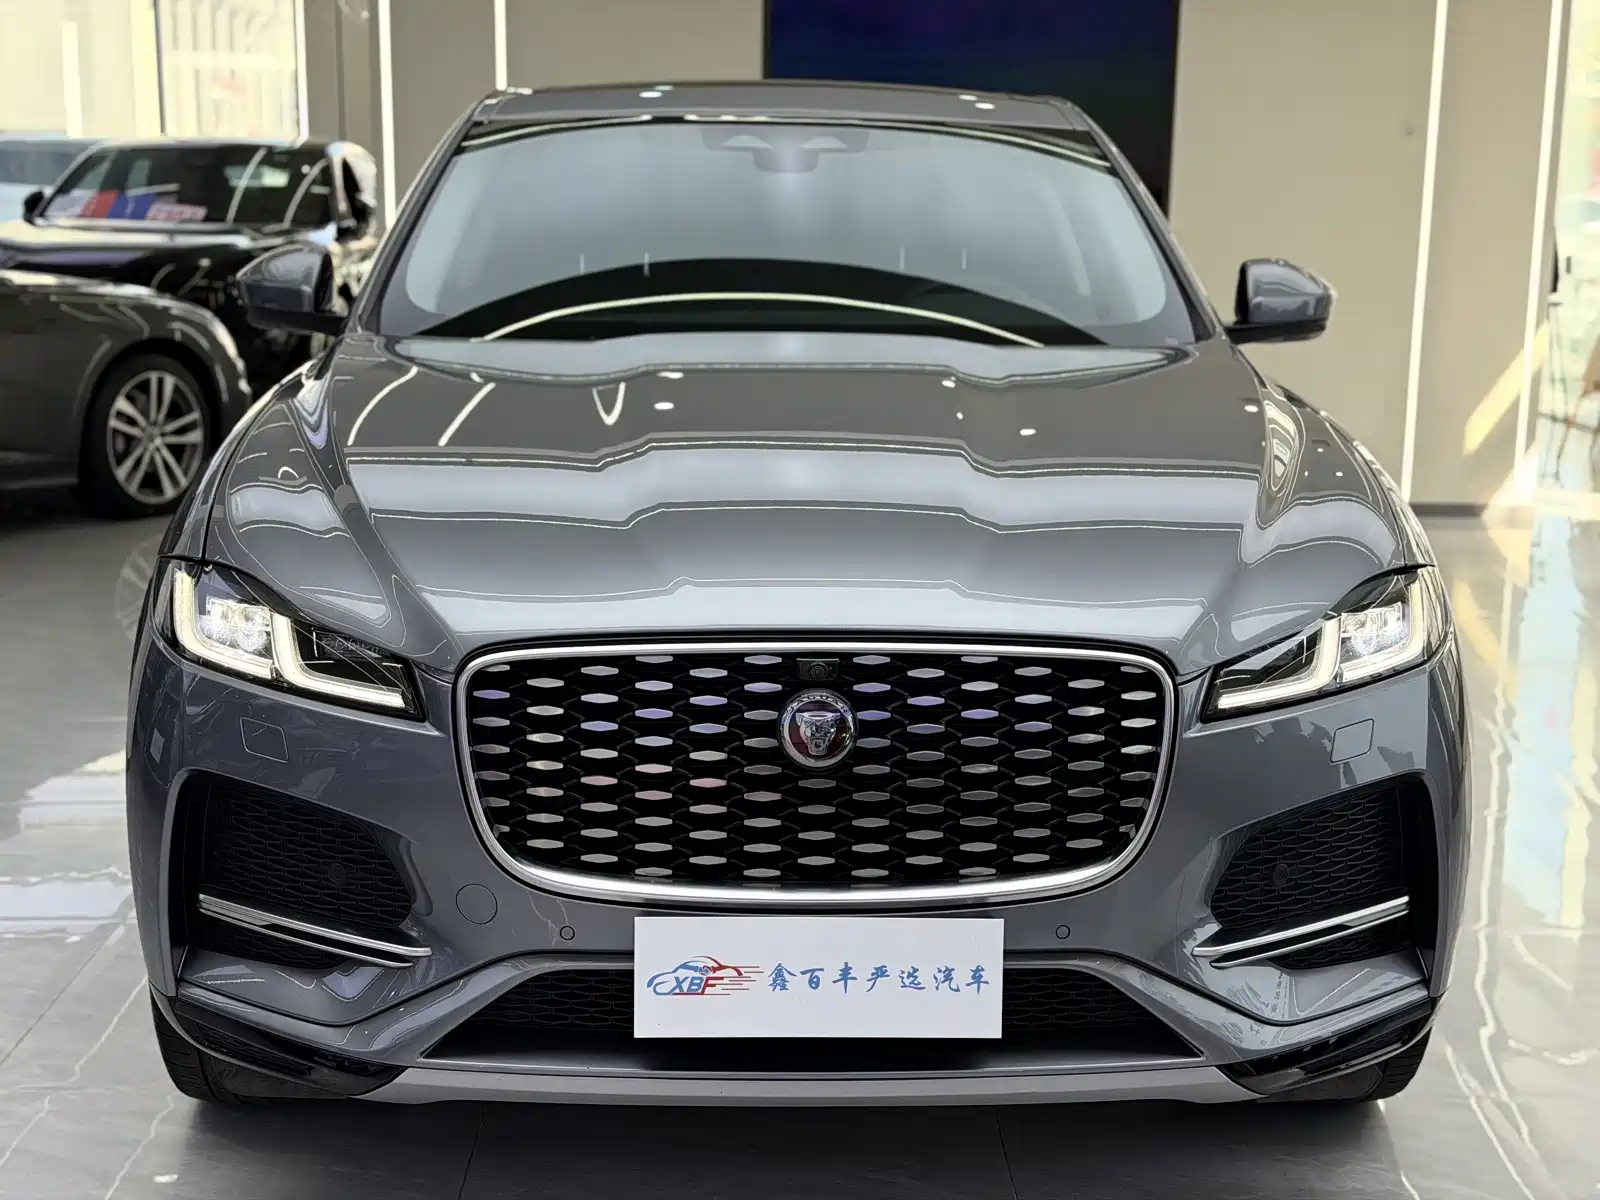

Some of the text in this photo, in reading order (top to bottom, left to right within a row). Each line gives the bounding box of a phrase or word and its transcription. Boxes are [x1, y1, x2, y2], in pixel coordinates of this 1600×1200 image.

[669, 976, 724, 995] XBF
[767, 961, 990, 994] 鑫百丰严选汽车
